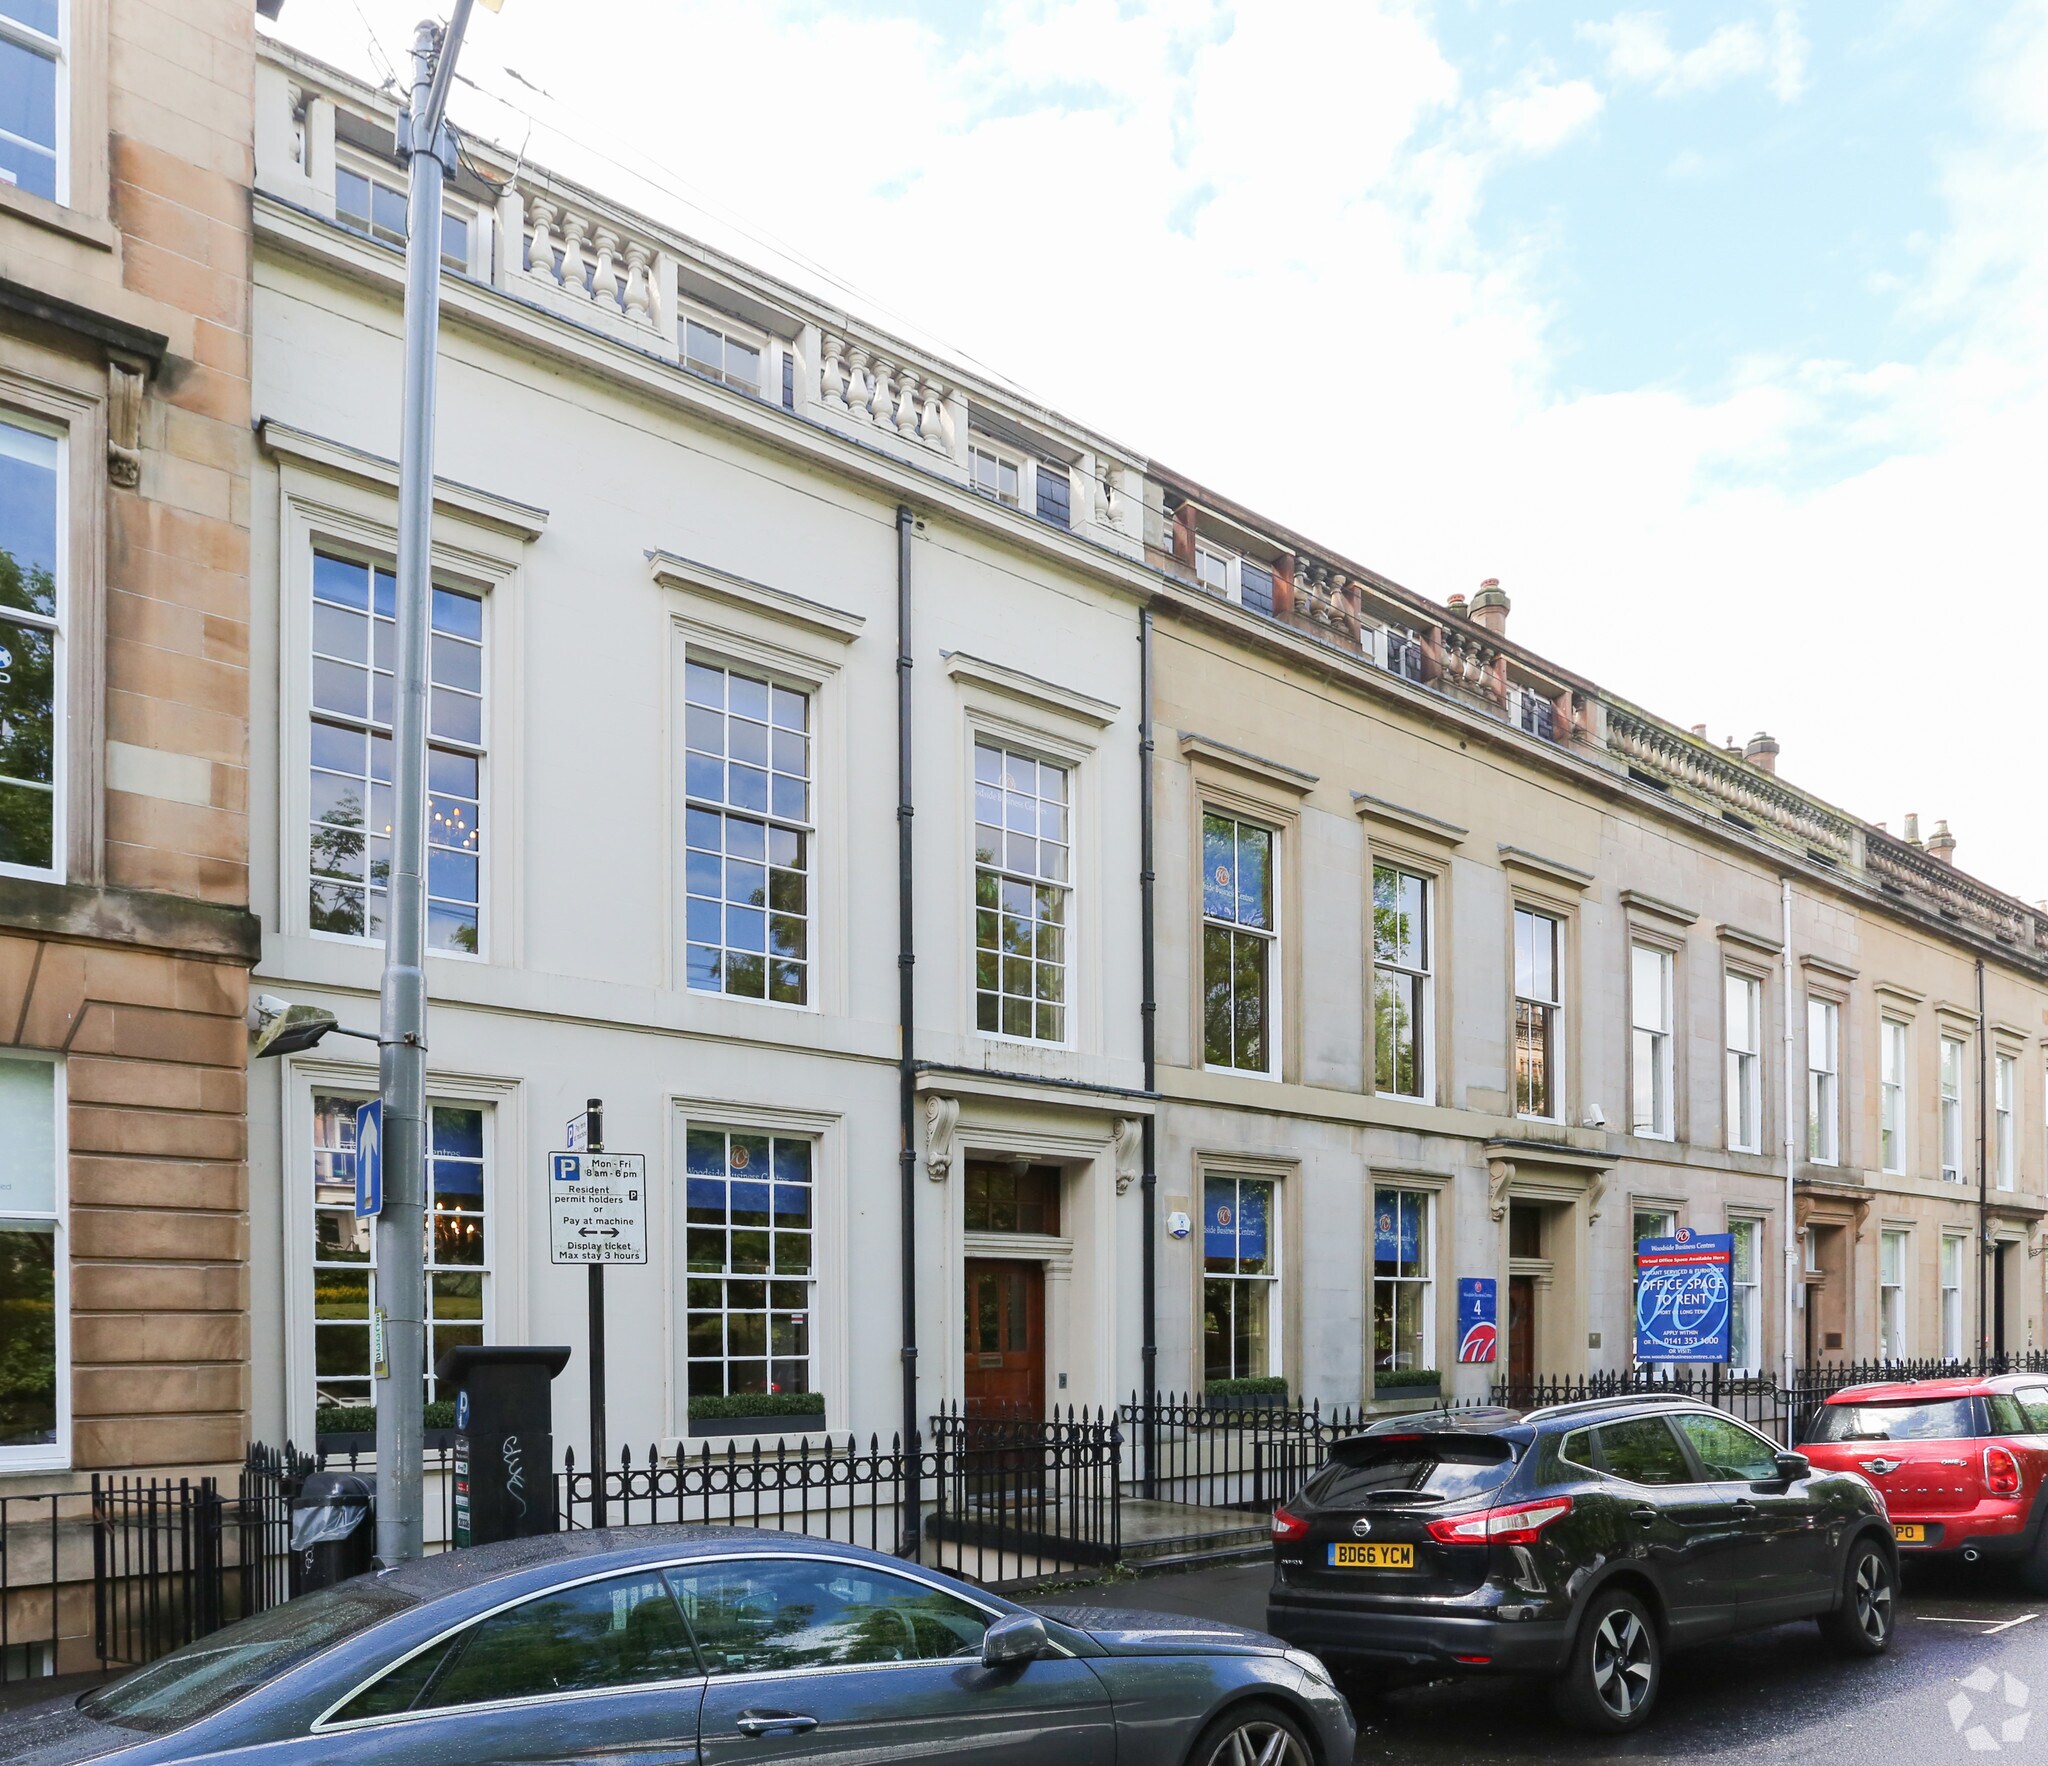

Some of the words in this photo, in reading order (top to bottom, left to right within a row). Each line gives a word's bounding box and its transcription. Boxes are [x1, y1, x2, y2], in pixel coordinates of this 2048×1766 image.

[592, 1159, 611, 1168] Mon
[619, 1160, 631, 1168] Fri
[561, 1159, 576, 1179] P
[730, 1170, 759, 1180] usiness
[568, 1185, 610, 1194] Resident
[555, 1196, 585, 1204] permit
[589, 1196, 623, 1204] holders
[563, 1217, 580, 1226] Pay
[596, 1217, 634, 1226] machine
[567, 1241, 601, 1251] Display
[604, 1242, 631, 1250] ticket
[559, 1251, 578, 1260] Max
[582, 1252, 601, 1261] stay
[605, 1252, 611, 1260] 3
[613, 1252, 640, 1260] hours
[1641, 1279, 1683, 1291] OFFICE
[1687, 1278, 1724, 1289] SPACE
[1655, 1294, 1672, 1305] TO
[1677, 1293, 1707, 1305] RENT
[1474, 1299, 1481, 1315] 4
[1339, 1546, 1376, 1563] BD66
[1380, 1547, 1410, 1564] YCM
